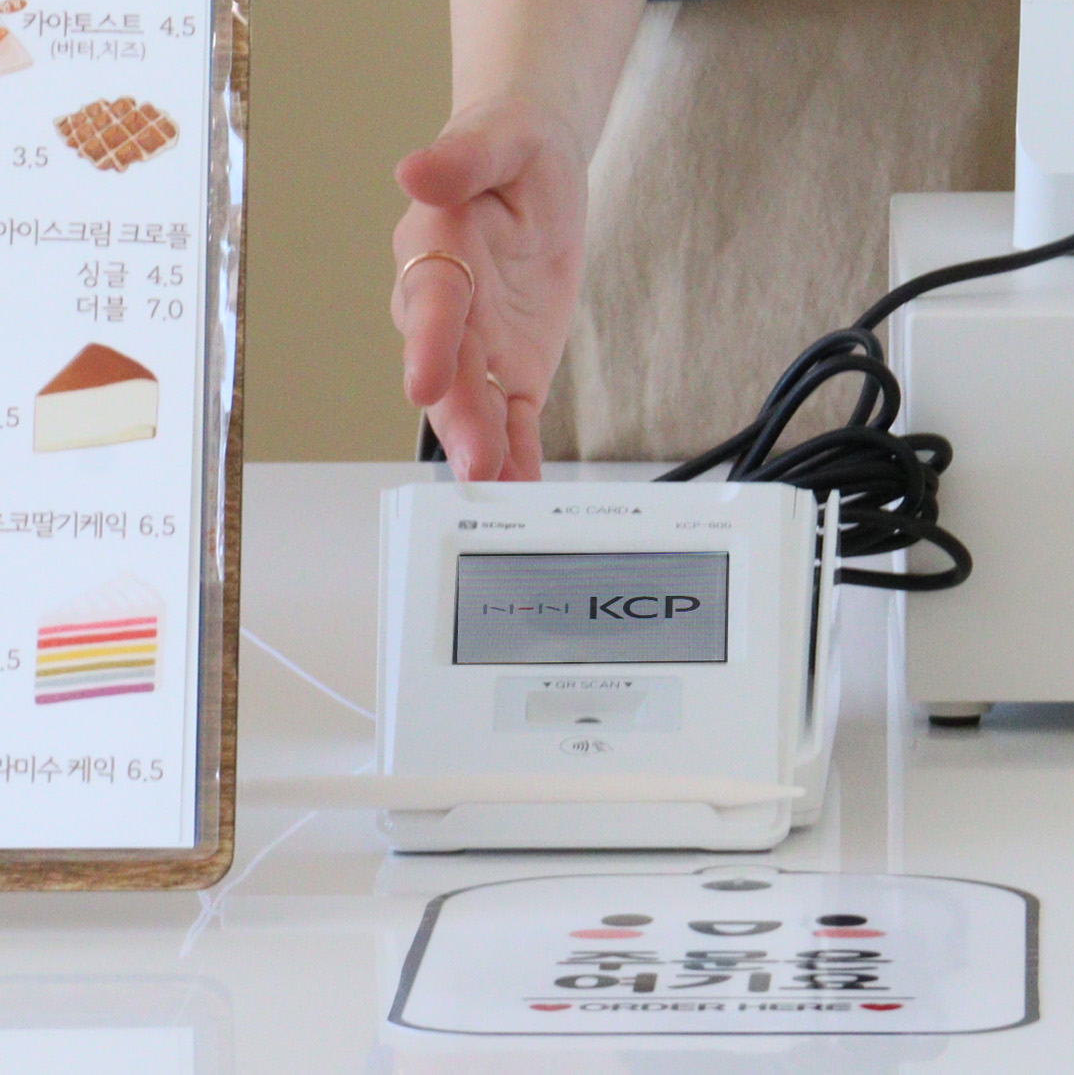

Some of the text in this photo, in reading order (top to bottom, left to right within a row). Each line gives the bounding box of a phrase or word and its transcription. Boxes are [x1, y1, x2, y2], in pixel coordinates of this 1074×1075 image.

[22, 10, 196, 38] 카야토스트 4.5
[50, 38, 147, 61] (버터,치즈)
[12, 146, 49, 169] 3.5
[0, 218, 192, 250] 아이스크림 크로플
[76, 260, 184, 289] 싱글 4.5
[76, 294, 184, 322] 더블 7.0
[138, 514, 176, 538] 6.5
[589, 595, 701, 620] KCP
[127, 758, 164, 783] 6.5
[553, 971, 892, 993] 여기요
[579, 1002, 852, 1012] ORDER HERE
